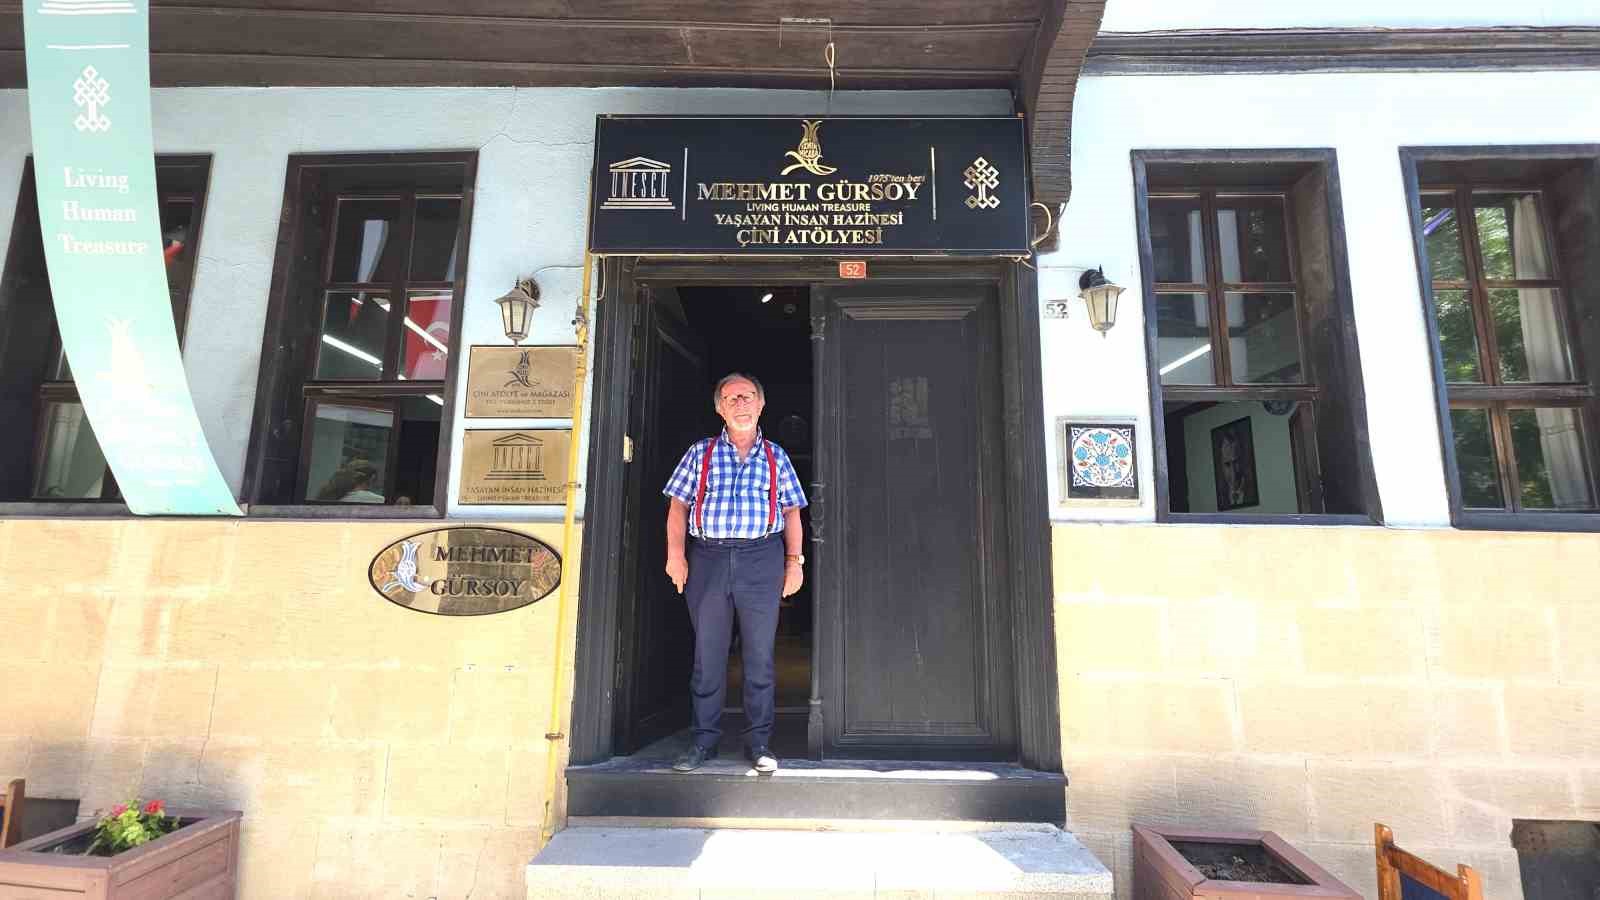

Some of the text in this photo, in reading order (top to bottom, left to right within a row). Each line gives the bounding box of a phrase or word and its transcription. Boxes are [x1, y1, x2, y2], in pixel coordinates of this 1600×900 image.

[63, 166, 129, 193] Living
[612, 172, 667, 198] UNESCO
[696, 180, 921, 201] MEHMET GÜRSOY
[63, 200, 137, 222] Human
[747, 203, 871, 212] LIVING HUMAN TREASURE
[715, 211, 903, 227] YAŞAYAN İNSAN HAZİNESİ
[57, 231, 148, 254] Treasure
[737, 226, 883, 247] ÇİNİ ATÖLYESİ
[847, 263, 860, 276] 52
[1046, 303, 1067, 315] 52
[434, 545, 537, 564] MEHMET
[430, 575, 523, 598] GÜRSOY
